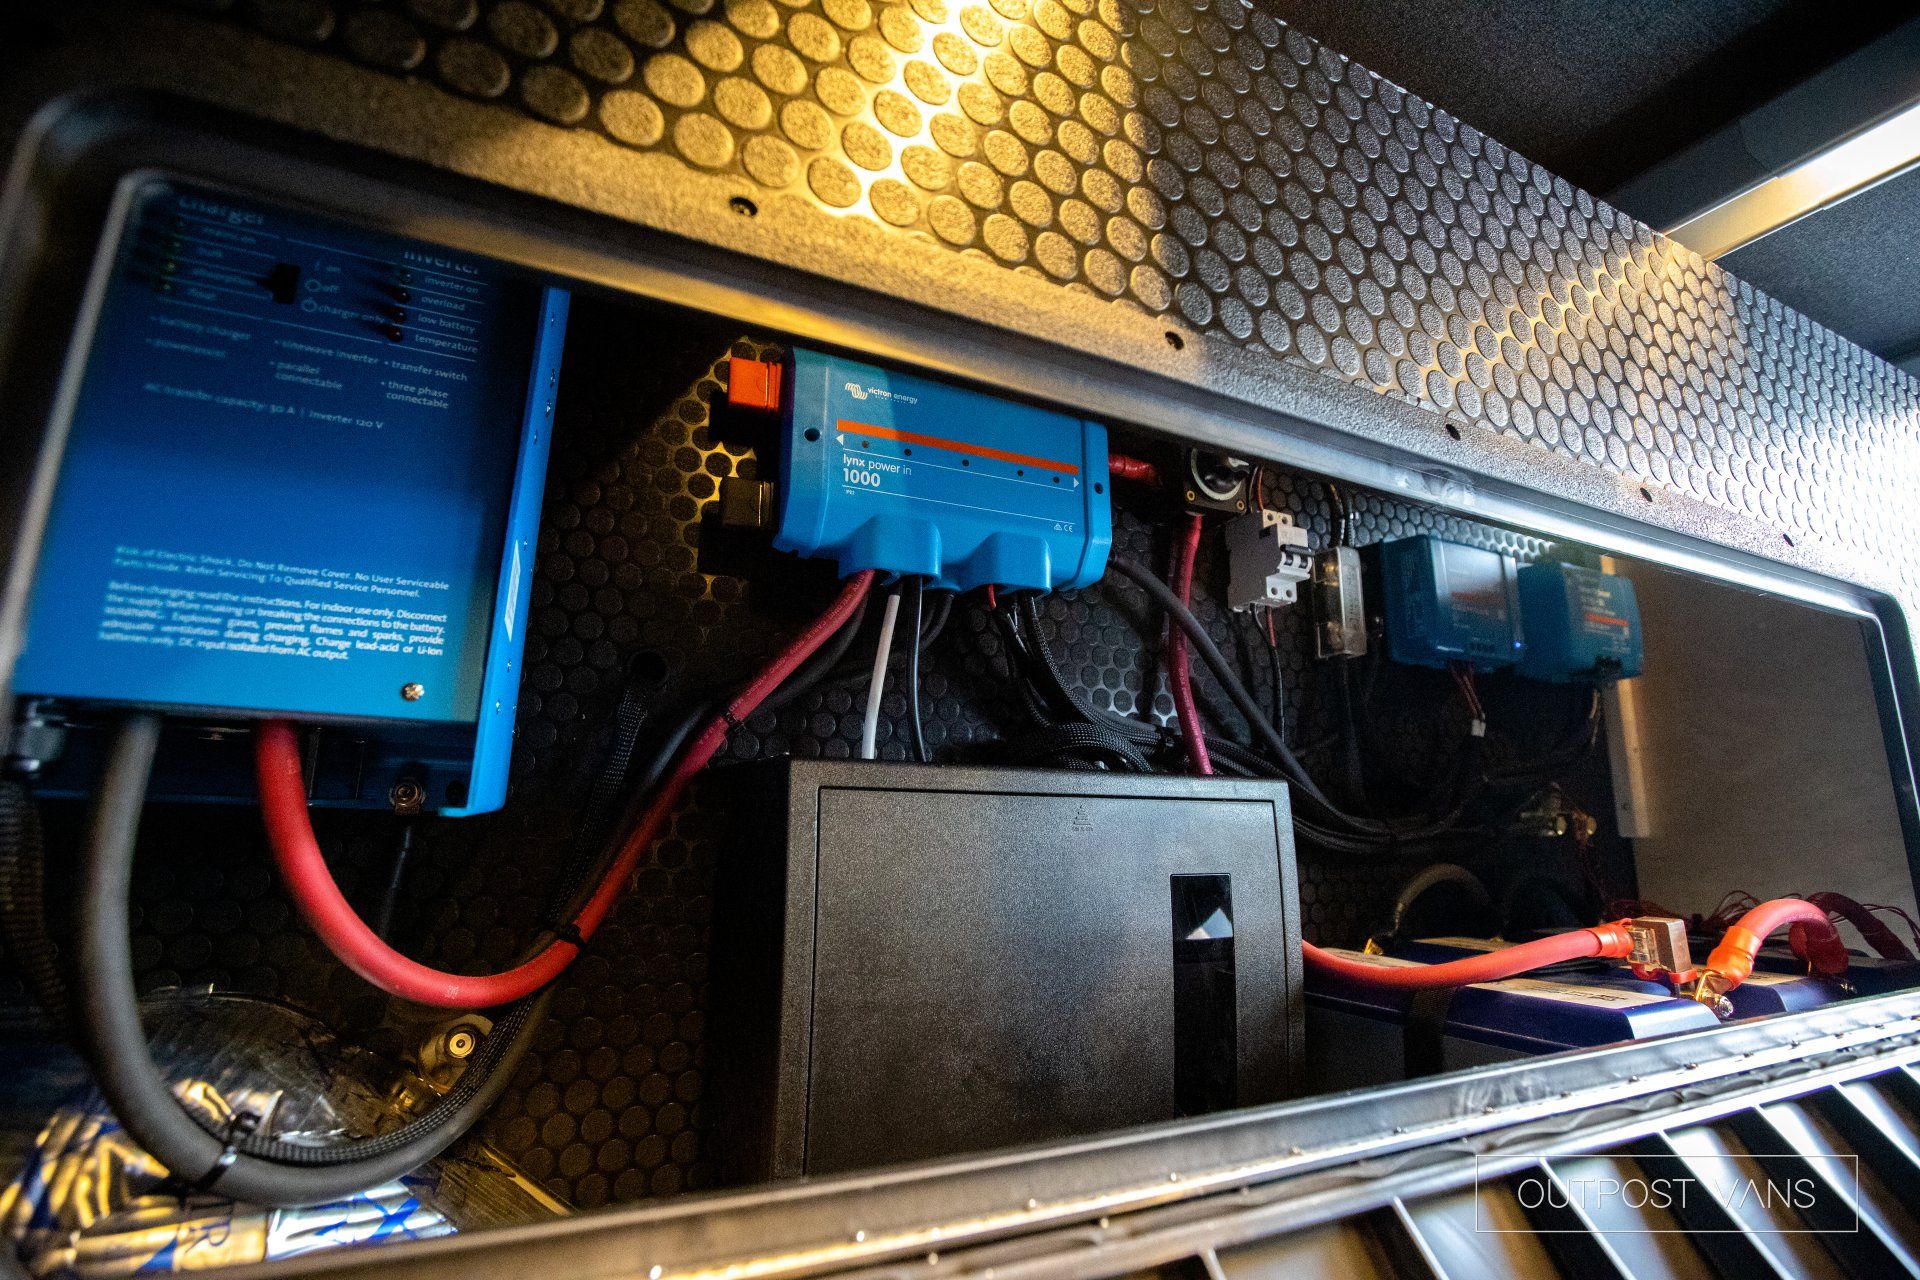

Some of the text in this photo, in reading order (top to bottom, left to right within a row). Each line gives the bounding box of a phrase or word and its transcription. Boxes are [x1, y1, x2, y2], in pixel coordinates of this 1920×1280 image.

[425, 277, 479, 294] inverter on
[422, 296, 465, 311] overload
[318, 305, 386, 324] charger only
[418, 314, 475, 334] low battery
[415, 334, 479, 354] temperature
[336, 350, 379, 364] inverter
[392, 361, 468, 382] transfer switch
[388, 381, 449, 398] three phase
[868, 386, 892, 398] victron
[893, 393, 918, 404] energy
[386, 392, 450, 409] connectable
[843, 454, 912, 476] lynx power in
[843, 468, 881, 488] 1000
[278, 564, 319, 576] Remove
[355, 572, 369, 582] No
[372, 574, 394, 584] User
[396, 577, 450, 590] Serviceable
[284, 576, 331, 588] Qualified
[334, 580, 369, 593] Service
[371, 585, 420, 598] Personnel.
[304, 600, 320, 610] For
[322, 602, 354, 614] indoor
[372, 607, 395, 620] only.
[396, 610, 448, 623] Disconnect
[258, 608, 302, 623] breaking
[304, 612, 321, 622] the
[321, 614, 380, 628] connections
[393, 621, 409, 631] the
[410, 622, 446, 636] battery.
[264, 622, 305, 633] prevent
[310, 624, 344, 636] flames
[348, 628, 368, 638] and
[409, 634, 444, 646] provide
[270, 644, 296, 656] from
[312, 649, 348, 661] output.
[316, 636, 352, 650] Charge
[356, 640, 400, 654] lead-acid
